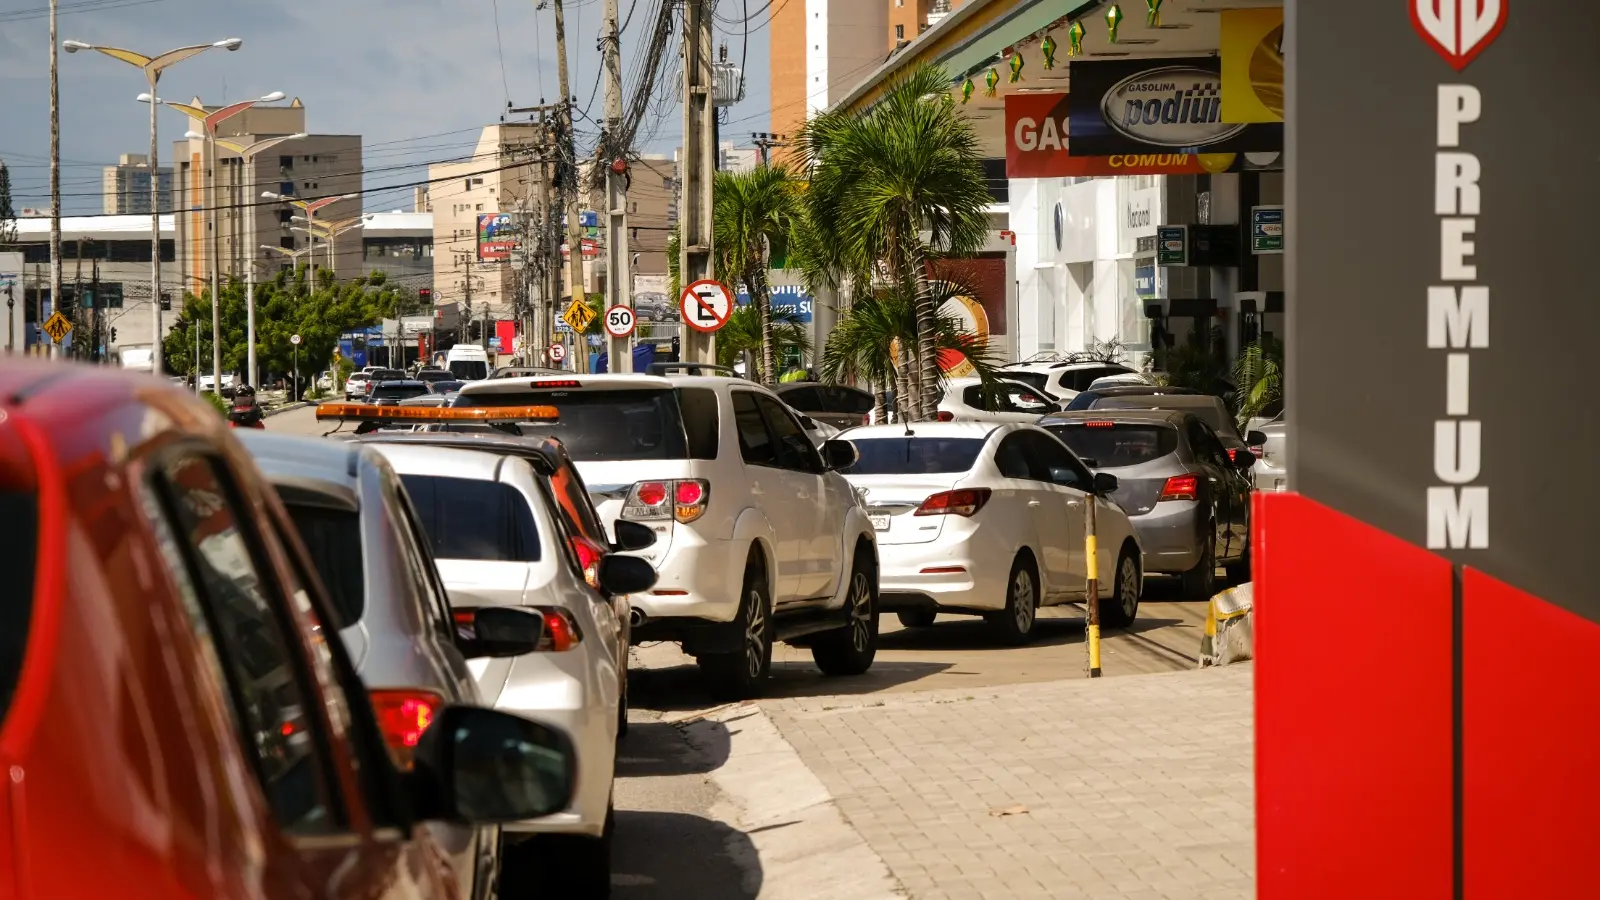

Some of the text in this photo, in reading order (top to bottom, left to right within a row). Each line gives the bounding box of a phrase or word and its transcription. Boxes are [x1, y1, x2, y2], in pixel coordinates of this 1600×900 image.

[1128, 83, 1175, 93] GASOLINA
[1108, 153, 1188, 168] COMUM
[1127, 198, 1150, 228] Nacional
[698, 292, 716, 320] E
[1427, 84, 1489, 549] PREMIUM
[610, 312, 630, 325] 50
